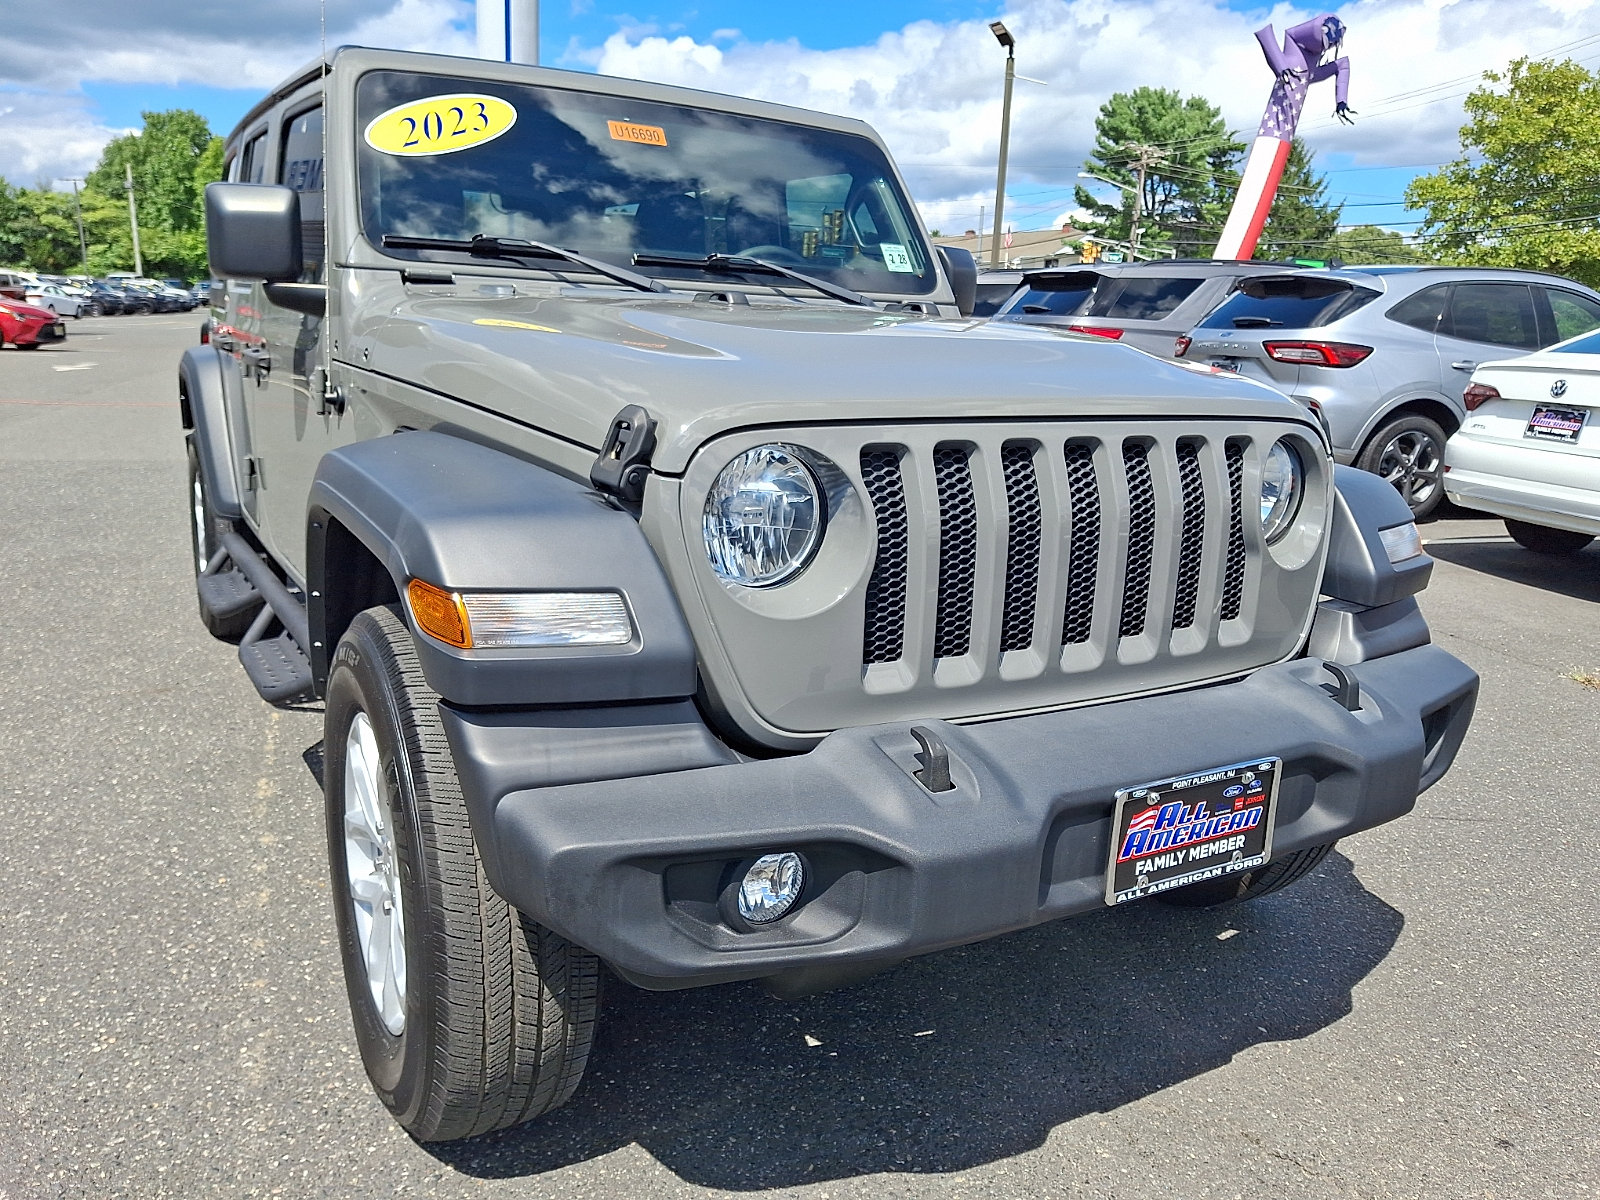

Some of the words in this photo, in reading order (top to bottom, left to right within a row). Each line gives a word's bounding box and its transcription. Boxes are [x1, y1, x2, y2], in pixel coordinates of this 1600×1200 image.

[400, 102, 489, 148] 2023
[614, 125, 660, 142] U16690
[1171, 779, 1192, 790] POINT
[1192, 771, 1227, 785] PLEASANT,
[1226, 769, 1236, 777] NJ
[1135, 850, 1187, 876] FAMILY
[1188, 835, 1246, 861] MEMBER
[1117, 888, 1145, 902] ALL
[1147, 867, 1222, 893] AMERICAN
[1225, 857, 1263, 873] FORD
